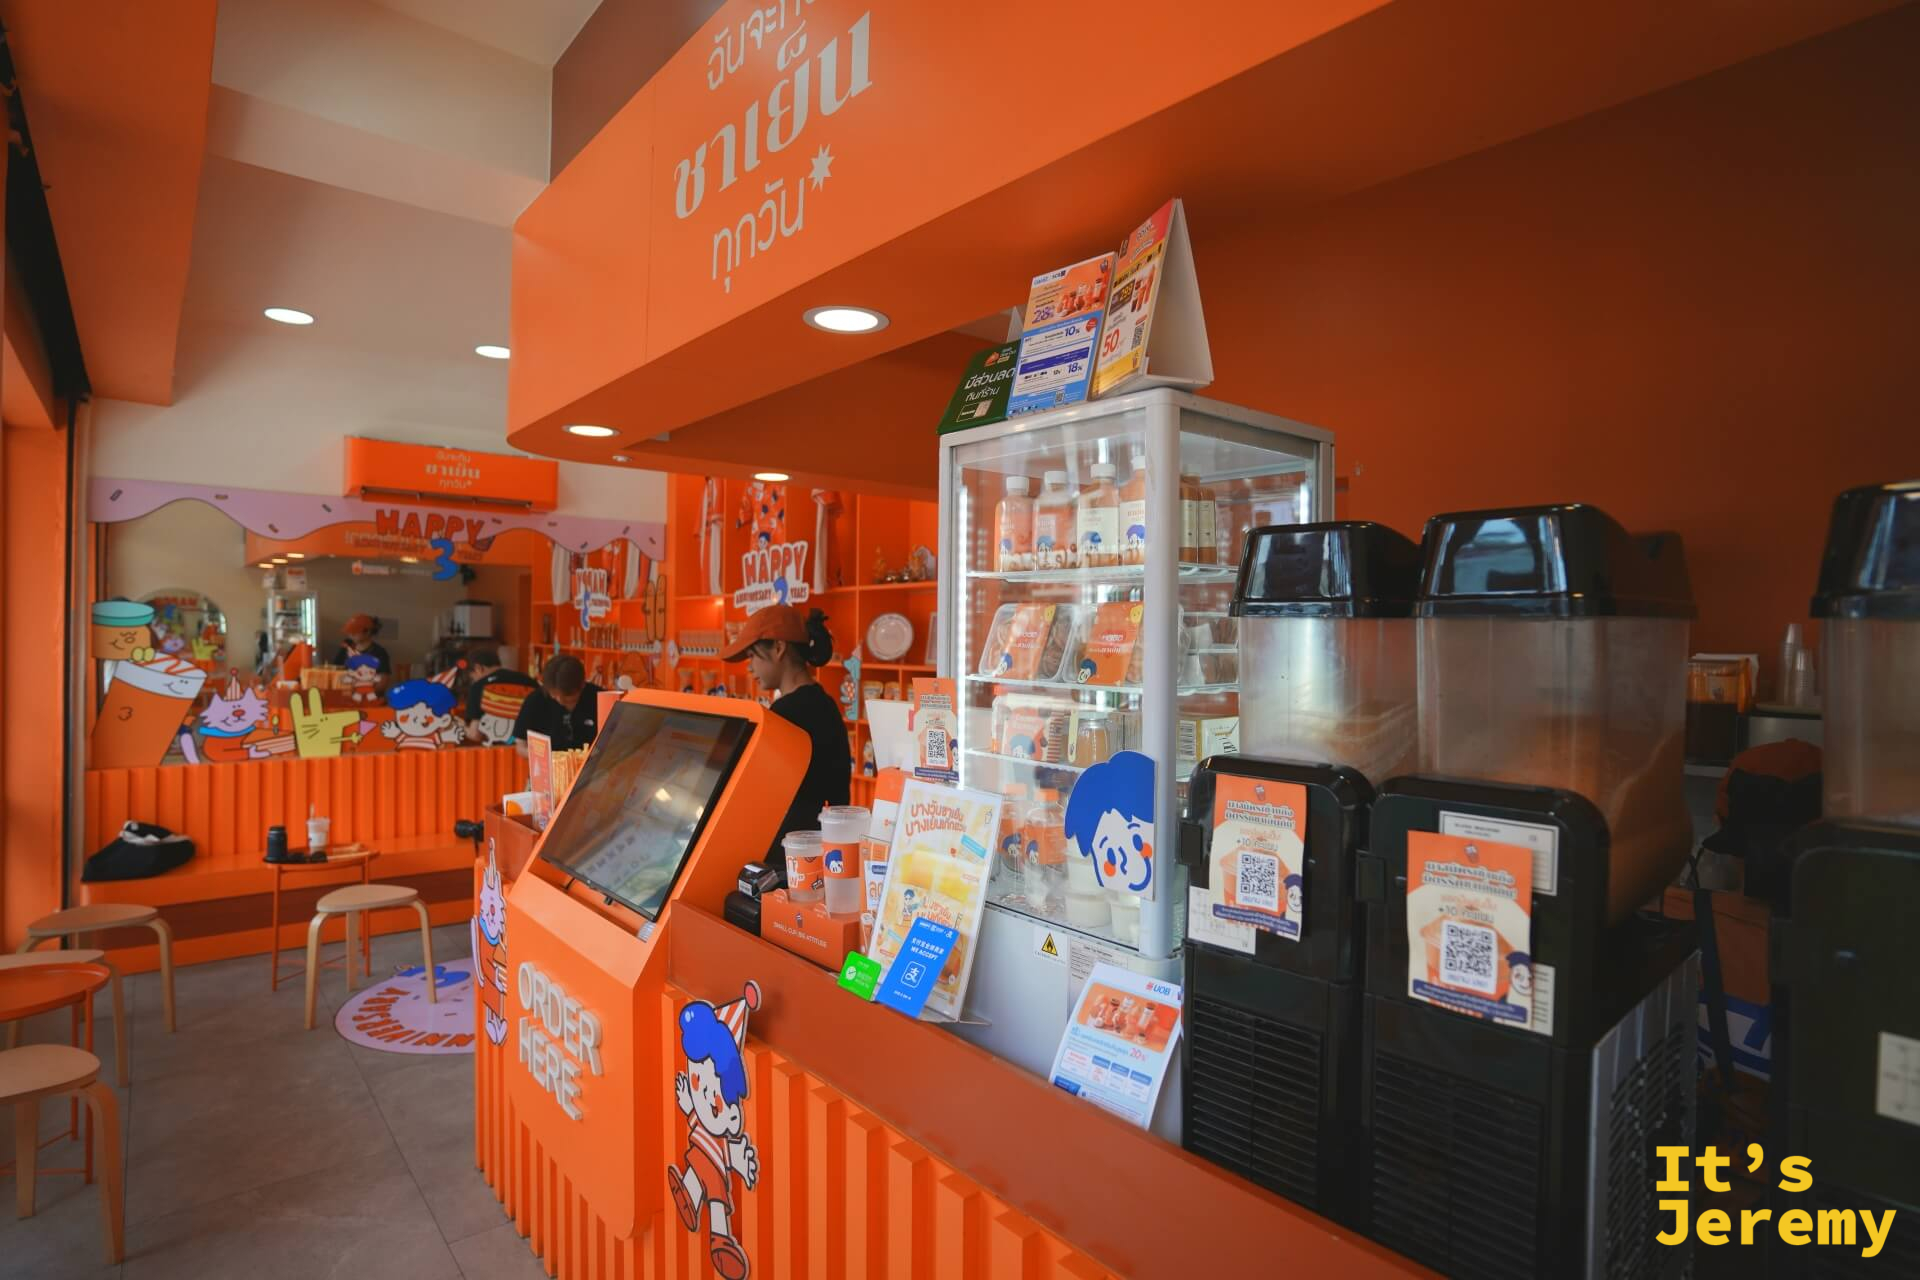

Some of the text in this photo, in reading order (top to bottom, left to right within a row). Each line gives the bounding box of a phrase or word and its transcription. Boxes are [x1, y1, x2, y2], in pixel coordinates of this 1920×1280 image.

[674, 10, 872, 219] ชาเย็น
[376, 508, 485, 546] HAPPY
[430, 538, 459, 581] 3
[744, 543, 807, 586] HAPPY
[1152, 983, 1171, 996] UOB
[518, 961, 604, 1077] ORDER
[519, 1015, 583, 1121] HERE
